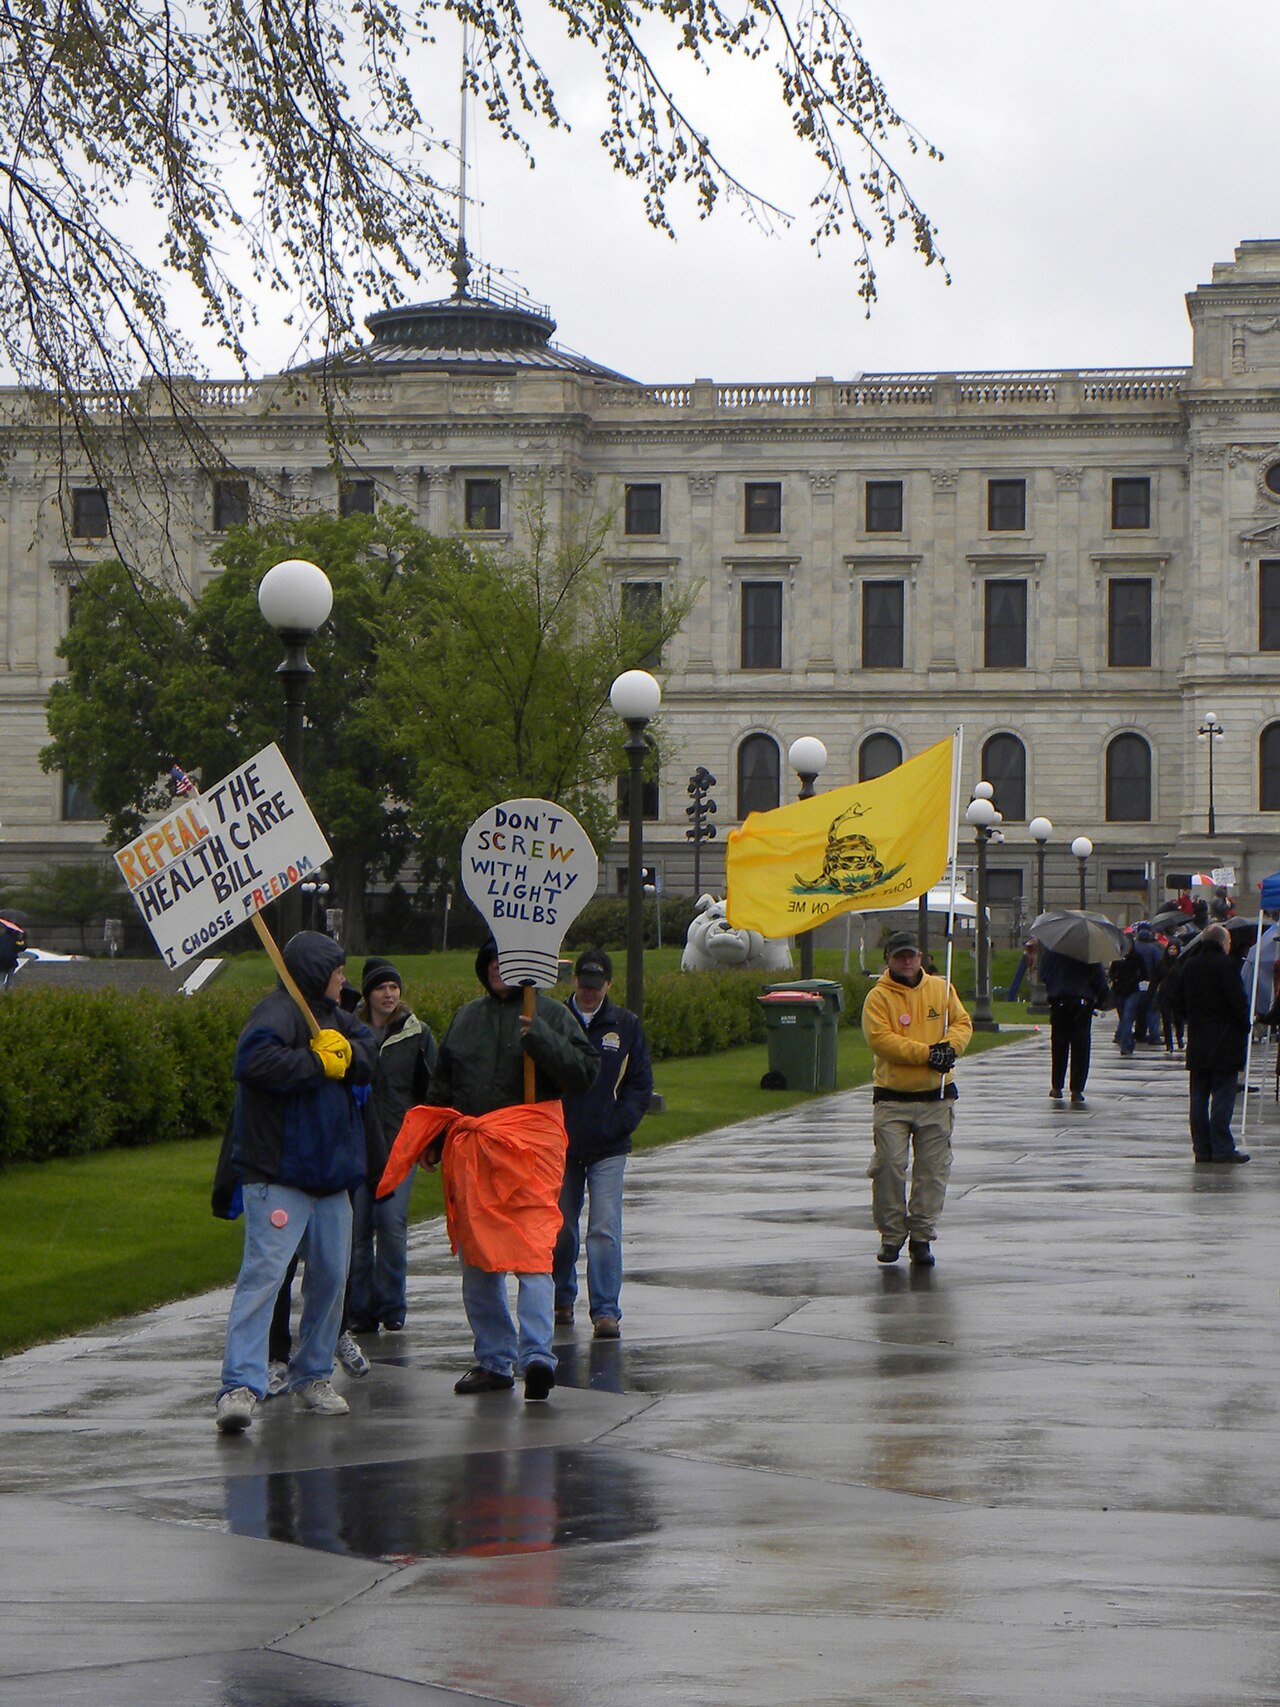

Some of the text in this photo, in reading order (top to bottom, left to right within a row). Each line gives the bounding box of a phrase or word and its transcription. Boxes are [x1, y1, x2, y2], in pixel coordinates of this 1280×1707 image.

[117, 763, 265, 889] REPEAL THE
[495, 808, 563, 834] DON'T
[139, 791, 294, 923] HEALTH CARE
[478, 831, 574, 862] SCREW
[210, 853, 263, 904] BILL
[471, 857, 578, 890] WITH MY
[487, 880, 561, 904] LIGHT
[164, 855, 313, 969] I CHOOSE FREEDOM
[493, 899, 558, 925] BULBS
